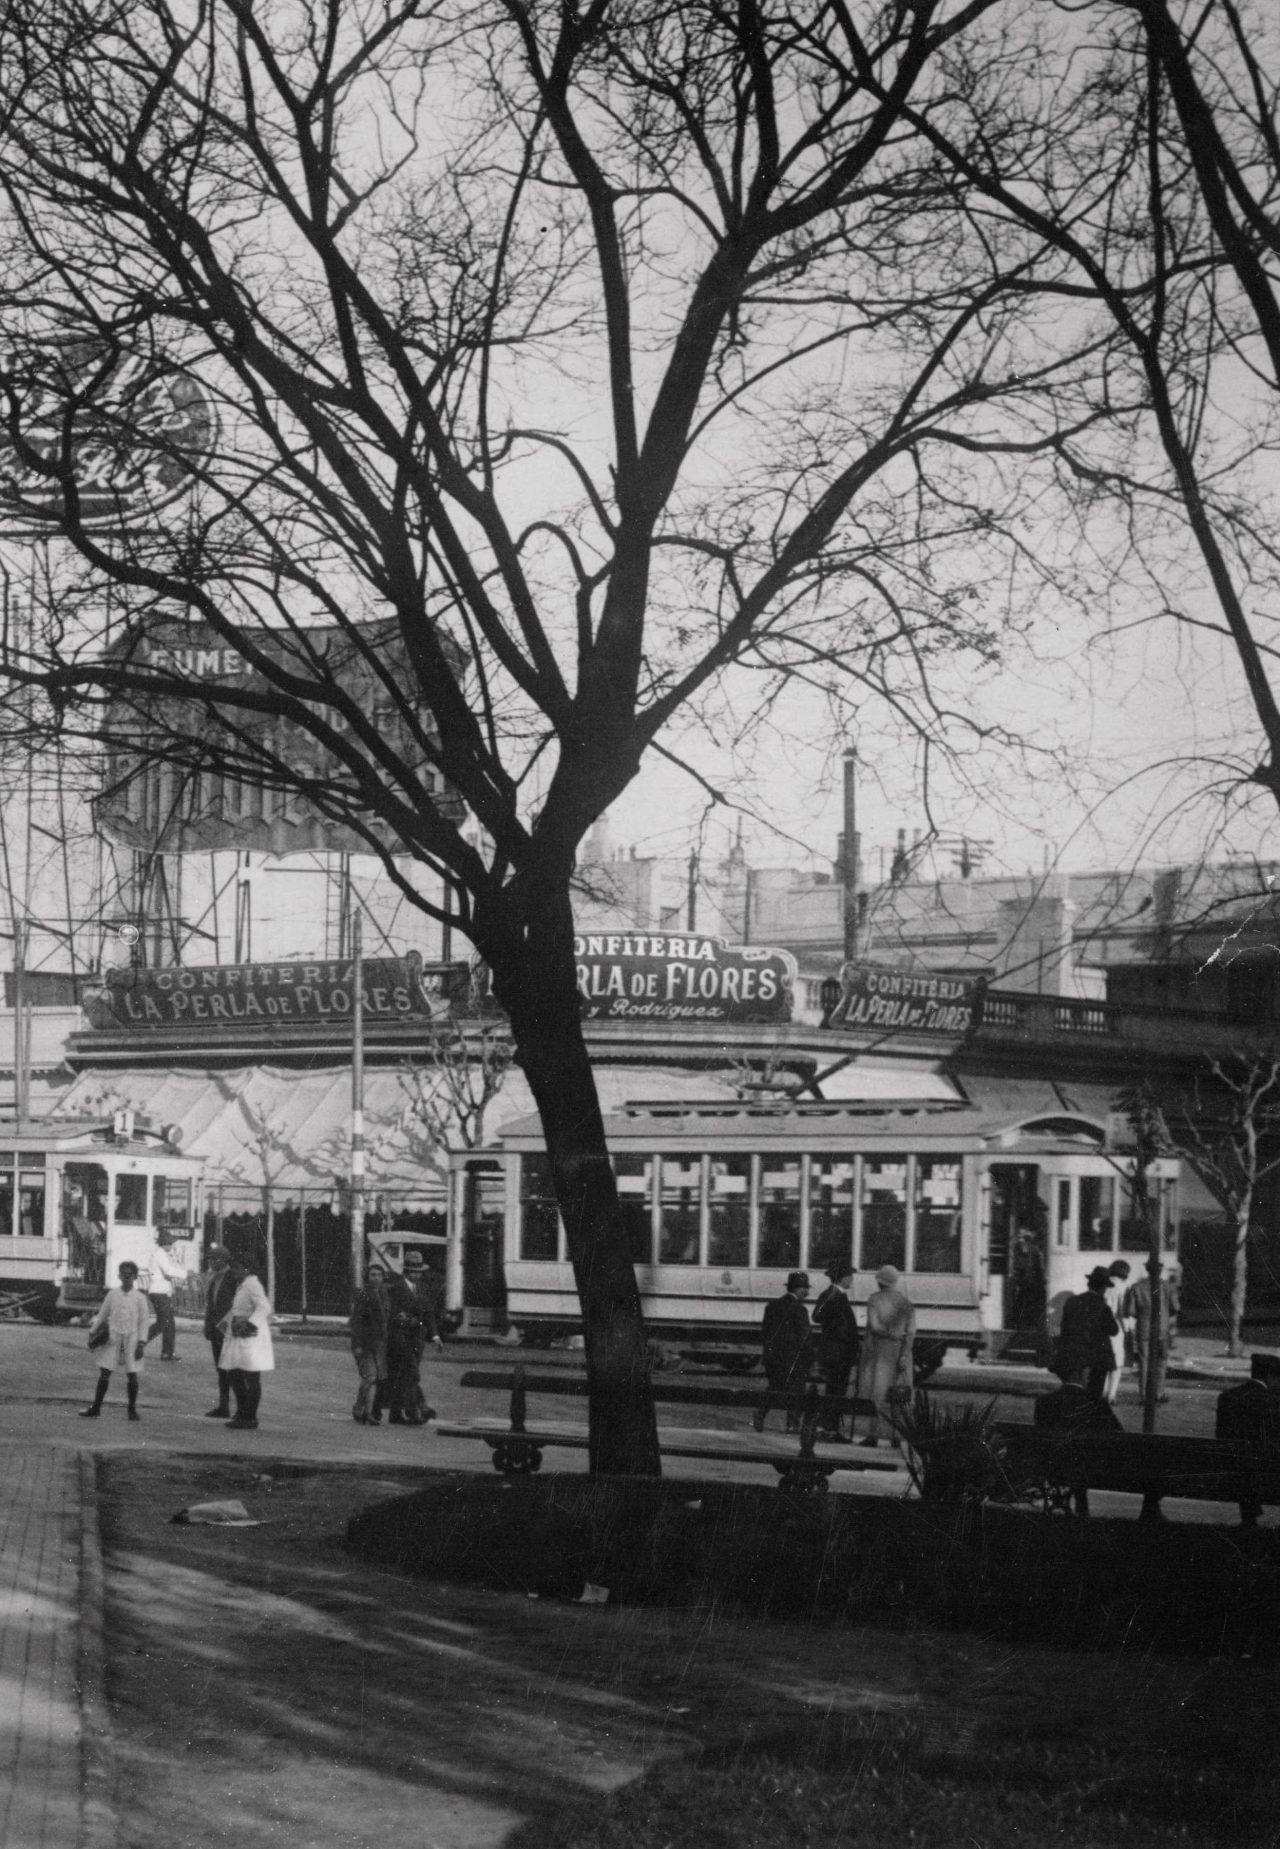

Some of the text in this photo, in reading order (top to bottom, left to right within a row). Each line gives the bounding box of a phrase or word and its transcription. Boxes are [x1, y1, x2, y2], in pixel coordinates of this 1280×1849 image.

[573, 935, 717, 962] ONFITERIA
[156, 963, 365, 990] CONFITERIA
[576, 961, 777, 1003] RLA DE FLORES
[866, 974, 965, 1000] CONFITERIA
[124, 985, 412, 1020] LA PERLA DE FLORES
[845, 994, 869, 1024] LA
[870, 995, 908, 1026] PERLA
[925, 1000, 972, 1031] FLORES
[120, 1113, 128, 1132] 1
